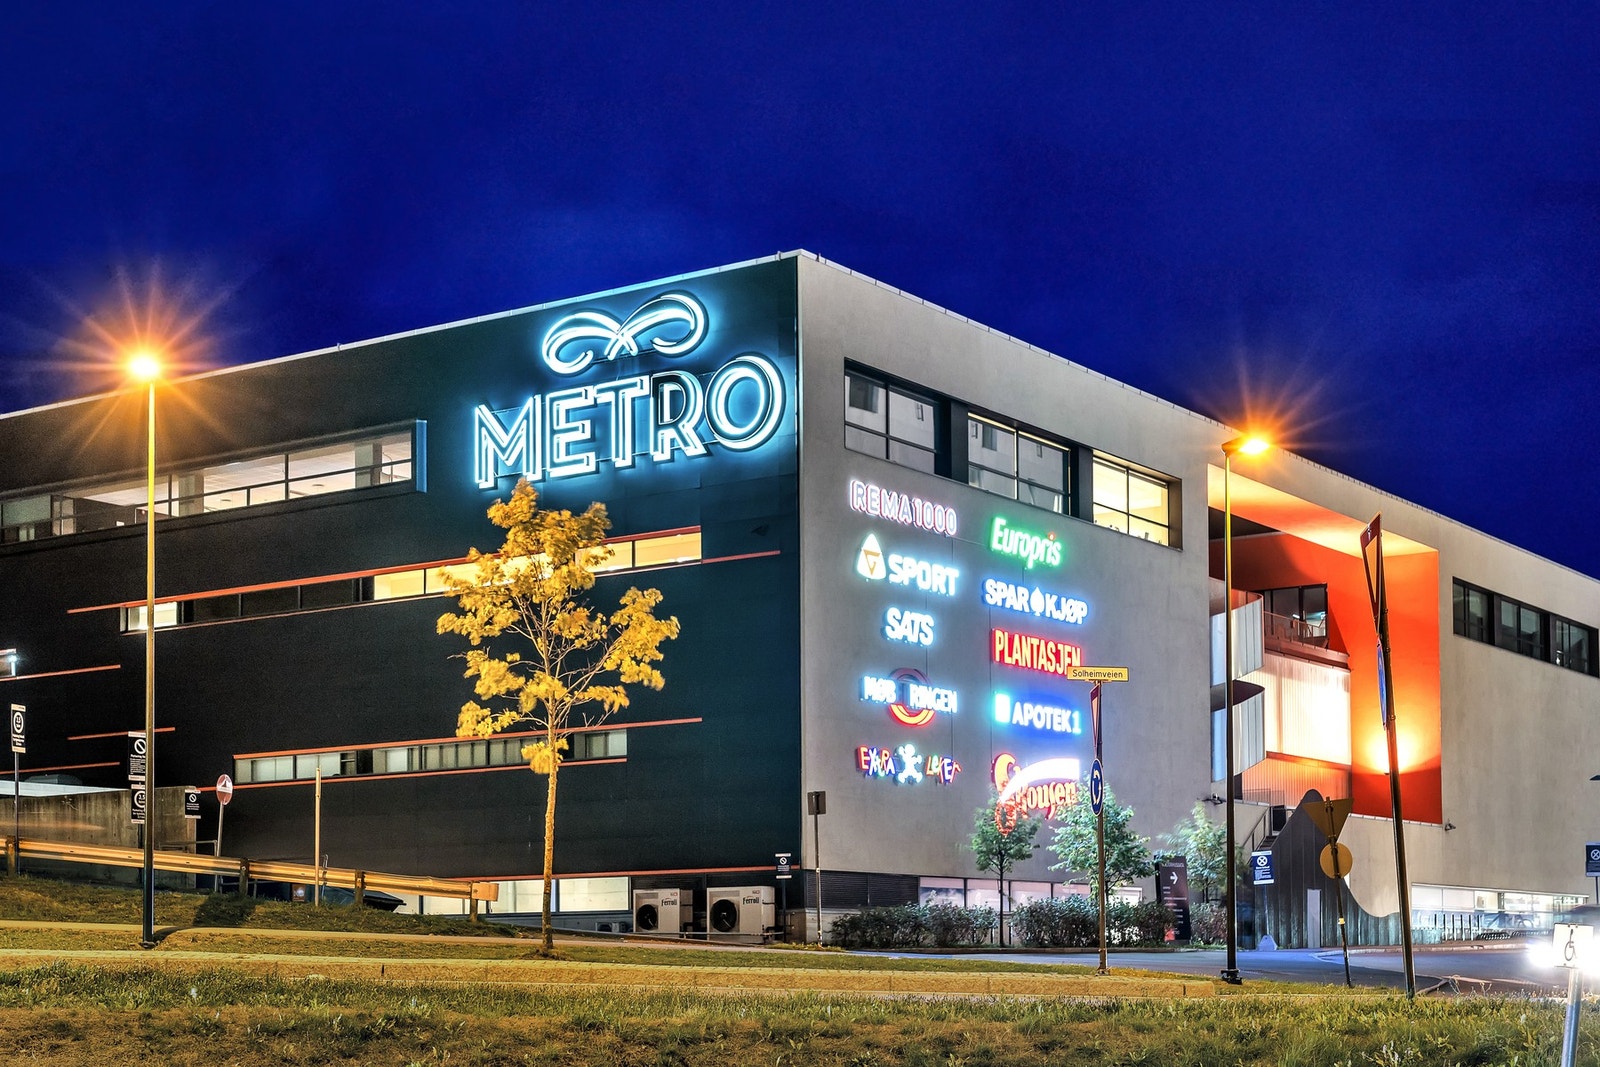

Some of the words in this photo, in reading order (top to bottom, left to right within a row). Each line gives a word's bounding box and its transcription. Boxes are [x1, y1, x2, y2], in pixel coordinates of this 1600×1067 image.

[474, 355, 786, 489] METRO
[990, 516, 1062, 569] Europris
[888, 553, 960, 597] SPORT
[985, 578, 1030, 613] SPAR
[1044, 593, 1088, 625] KJØP
[885, 607, 935, 646] SATS
[1072, 669, 1123, 678] Solheimveien
[1011, 701, 1071, 733] APOTEK
[1071, 710, 1082, 735] 1
